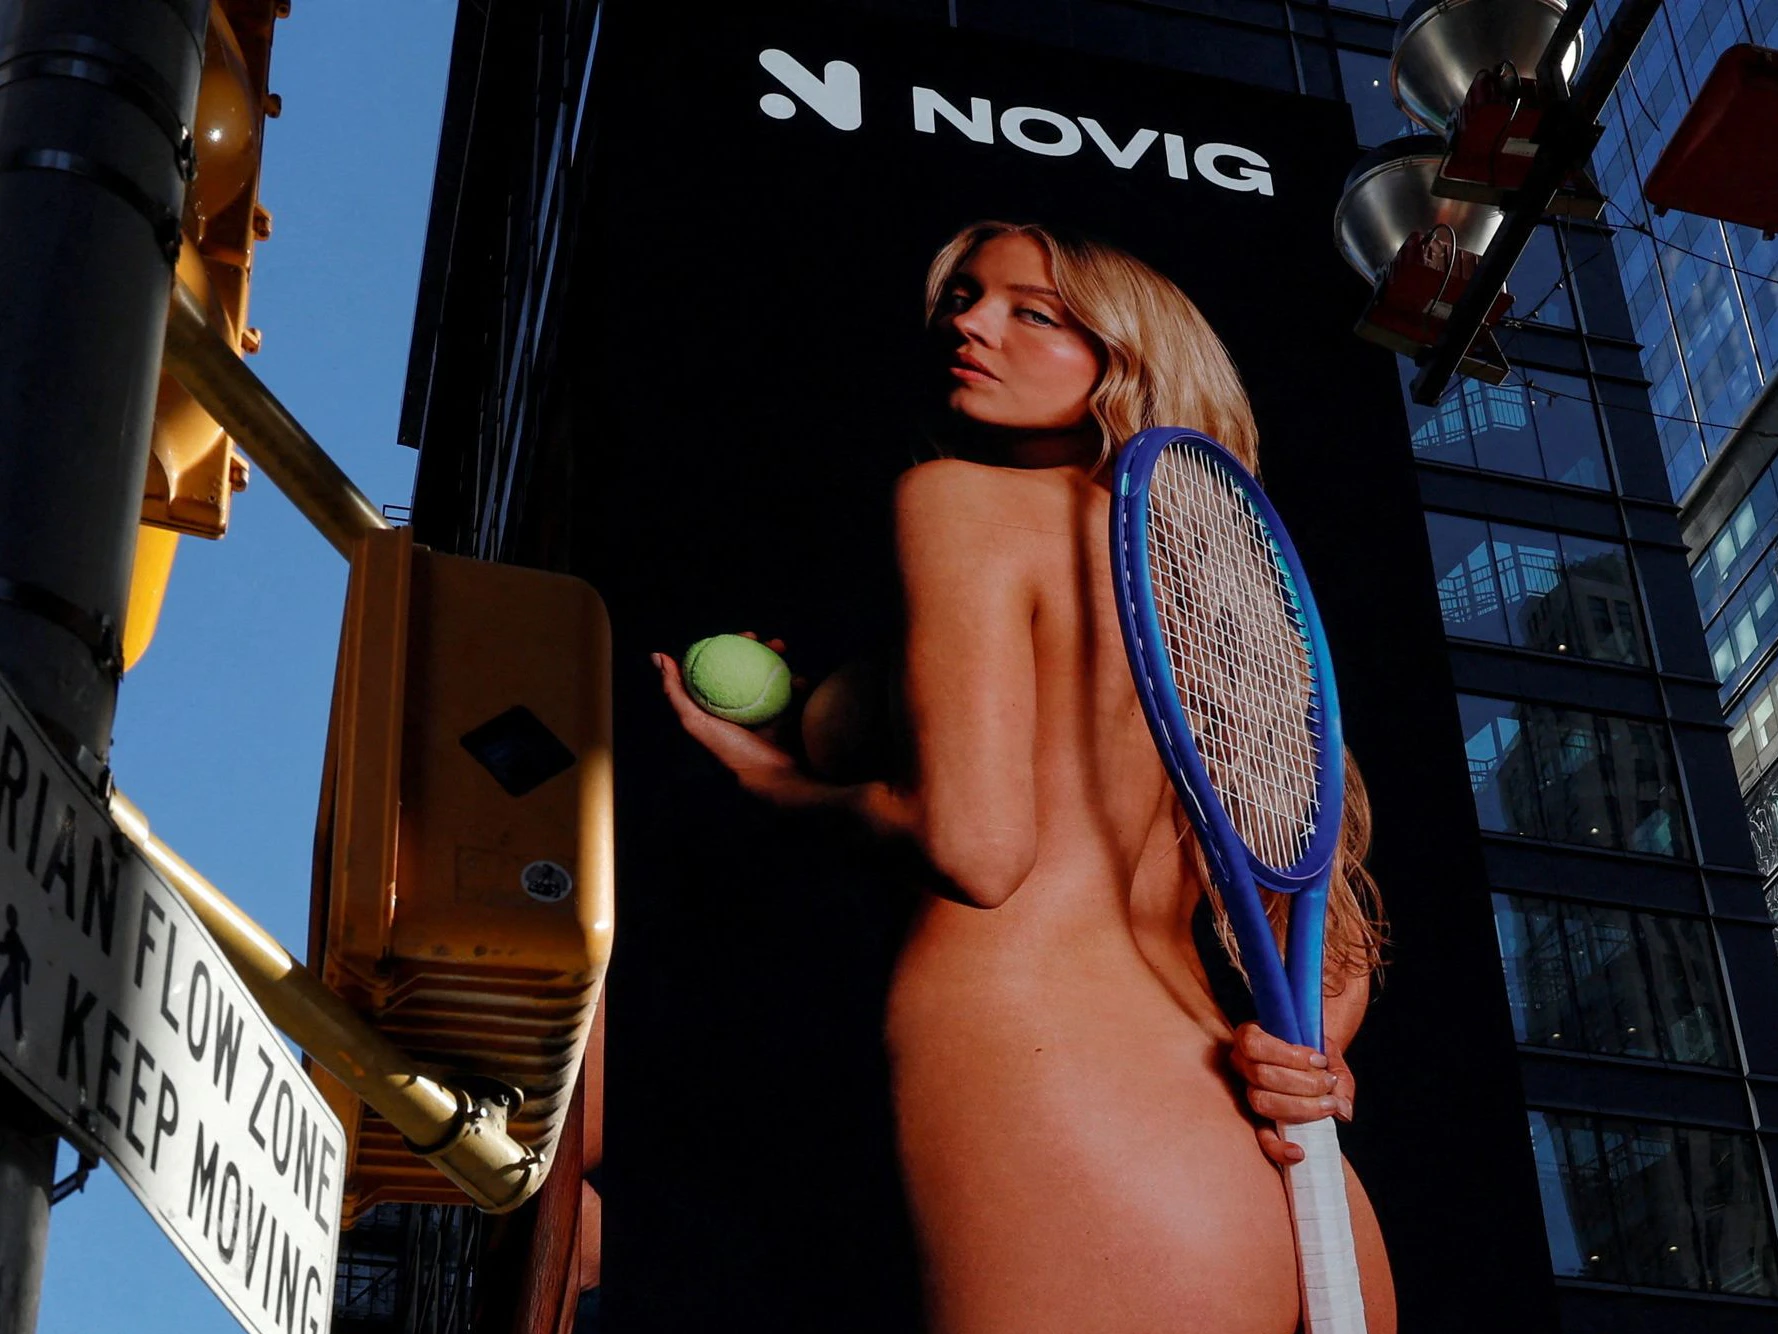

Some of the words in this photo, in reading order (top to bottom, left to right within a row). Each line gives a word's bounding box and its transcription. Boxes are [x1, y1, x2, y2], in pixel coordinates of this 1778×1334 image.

[913, 86, 1274, 195] NOVIG
[57, 974, 178, 1175] KEEP
[134, 888, 243, 1104] FLOW
[249, 1045, 335, 1236] ZONE
